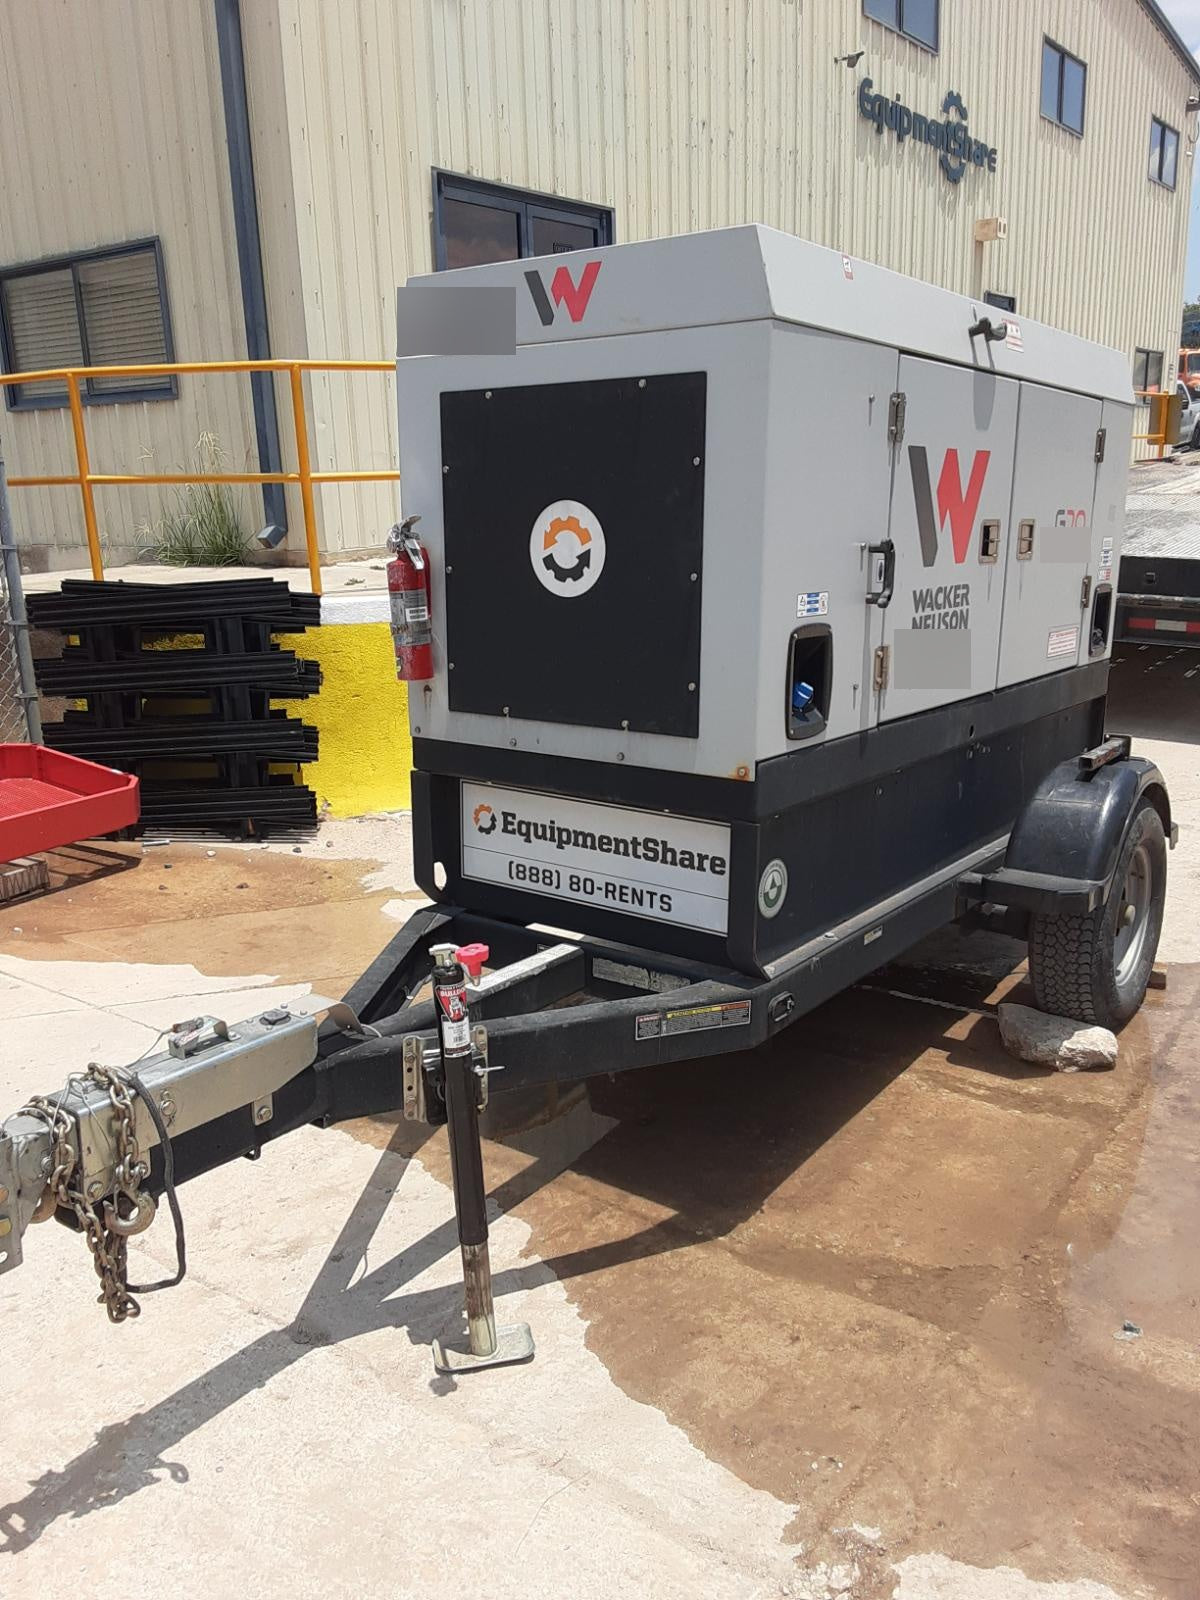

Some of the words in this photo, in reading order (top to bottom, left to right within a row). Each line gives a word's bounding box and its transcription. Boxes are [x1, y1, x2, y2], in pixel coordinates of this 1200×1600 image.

[859, 77, 998, 173] EquipmentShare
[912, 584, 970, 614] WACKER
[501, 811, 727, 876] EquipmentShare
[508, 860, 561, 890] (888)
[569, 874, 673, 913] 80-RENTS
